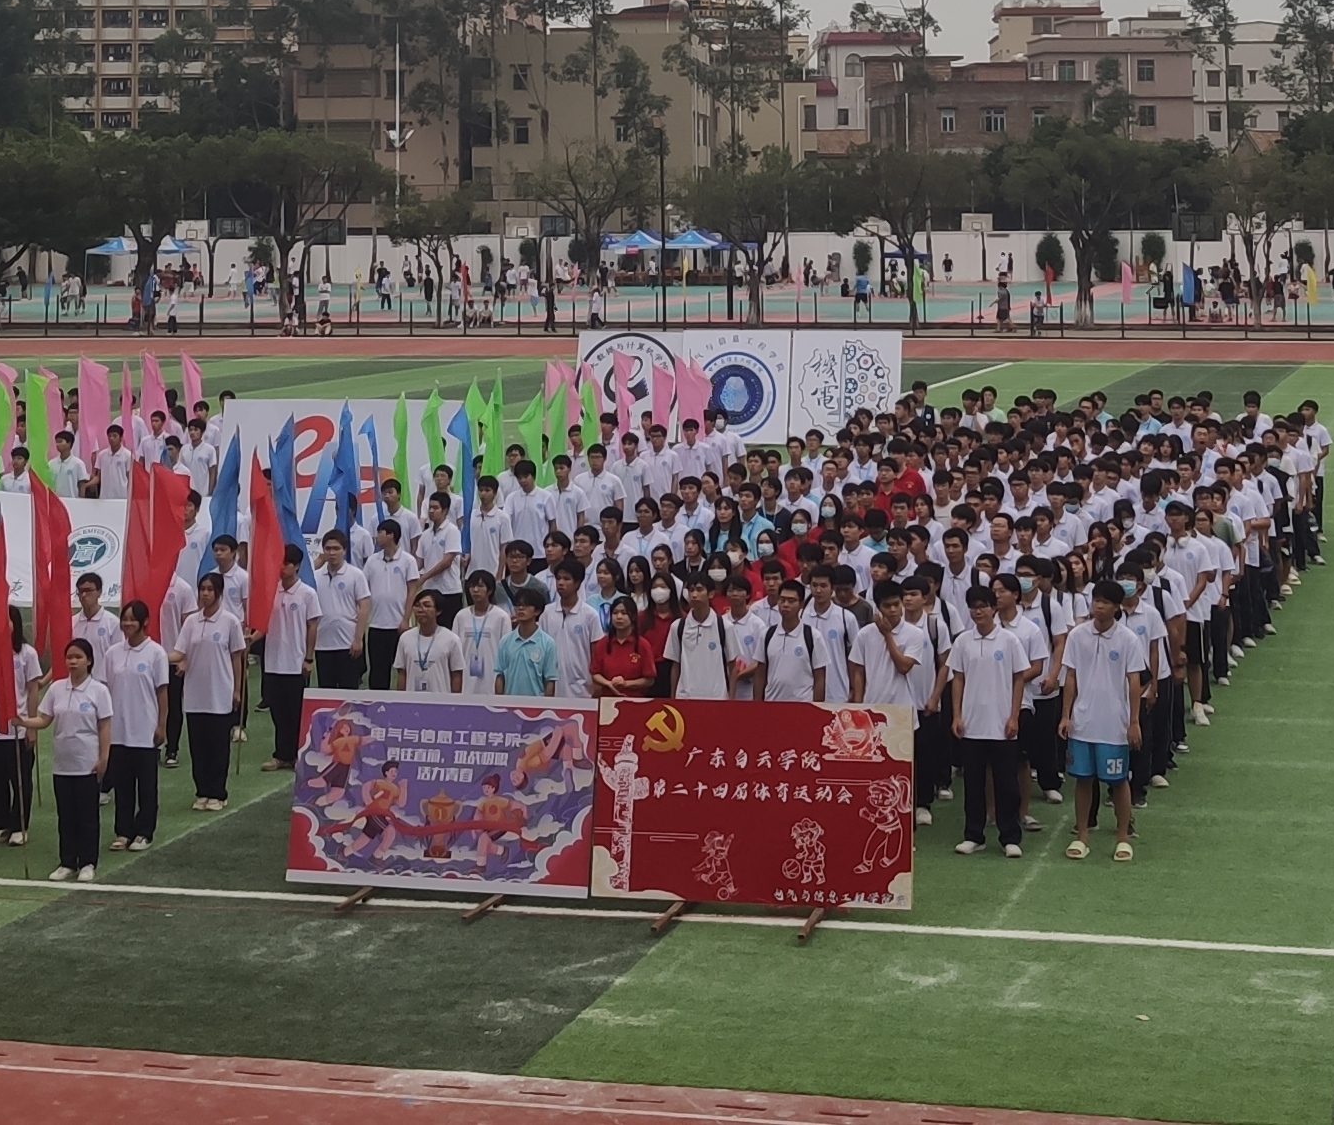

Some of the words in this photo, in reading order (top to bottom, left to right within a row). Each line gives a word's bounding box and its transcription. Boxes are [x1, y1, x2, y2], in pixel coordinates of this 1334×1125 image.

[370, 727, 522, 748] 电气与信息工程学院
[1106, 758, 1124, 775] 35
[652, 778, 854, 805] 第二十四届体育运动会
